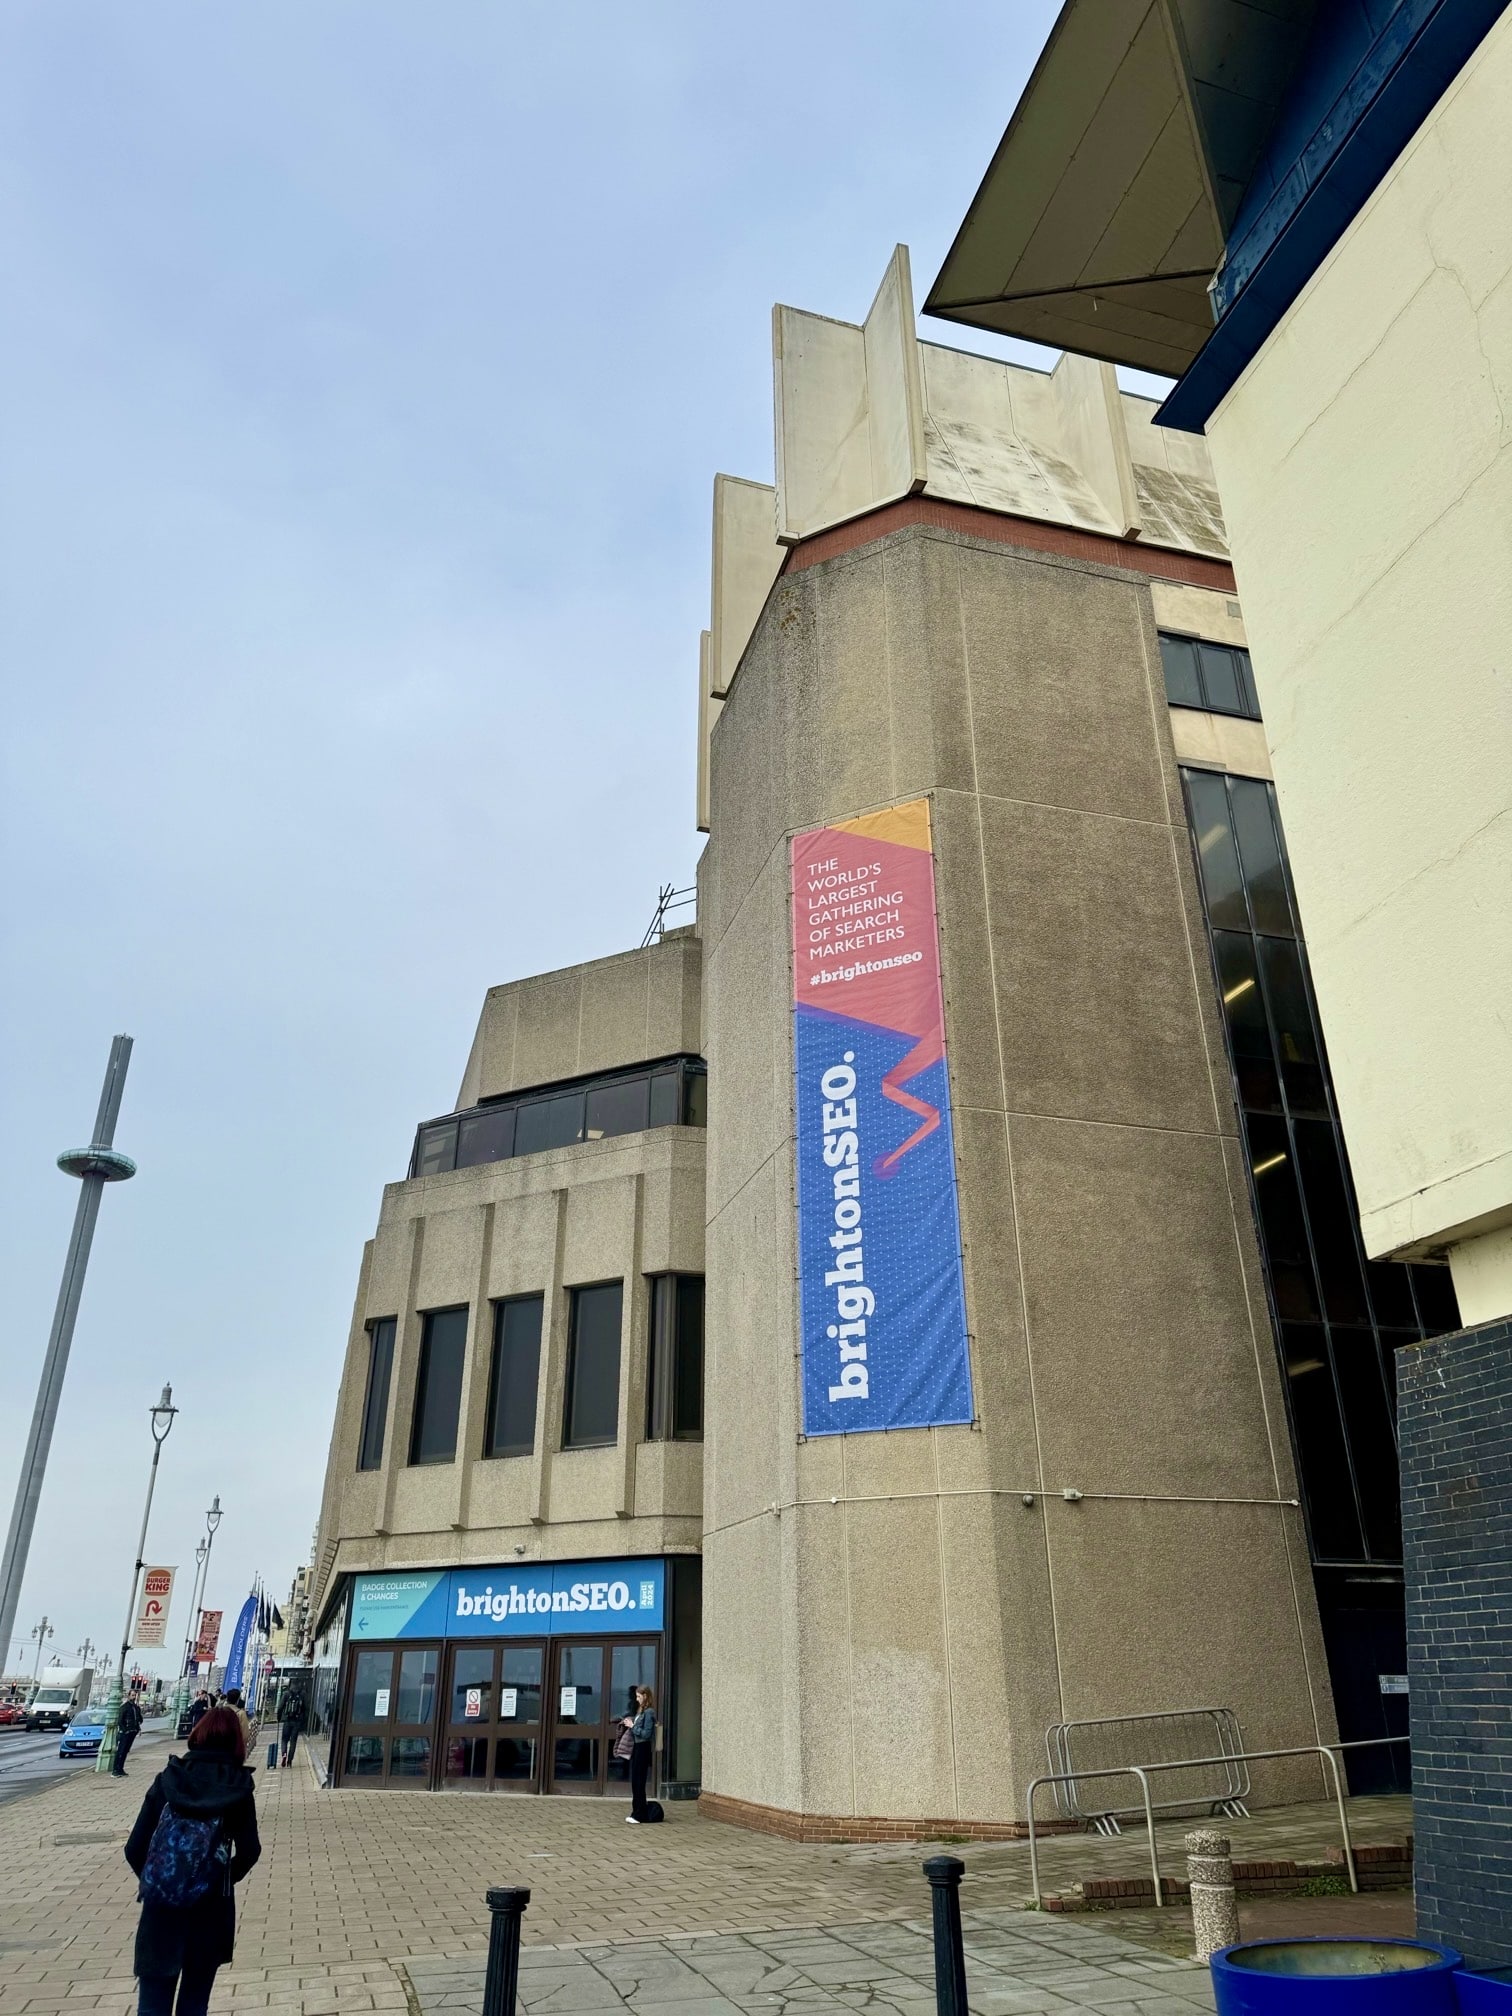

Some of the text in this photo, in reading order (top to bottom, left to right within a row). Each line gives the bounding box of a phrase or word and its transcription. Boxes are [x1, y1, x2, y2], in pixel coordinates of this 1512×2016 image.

[807, 858, 839, 876] THE
[807, 863, 882, 893] WORLD'S
[808, 880, 878, 910] LARGEST
[808, 891, 904, 926] GATHERING
[809, 909, 900, 943] OF SEARCH
[809, 926, 905, 960] MARKETERS
[809, 951, 923, 987] #brightonseo
[821, 1050, 875, 1403] brightonSEO.
[145, 1583, 170, 1592] KING
[360, 1592, 399, 1601] & CHANGES
[361, 1581, 428, 1592] BADGE COLLECTION
[456, 1581, 636, 1622] brightonSEO.
